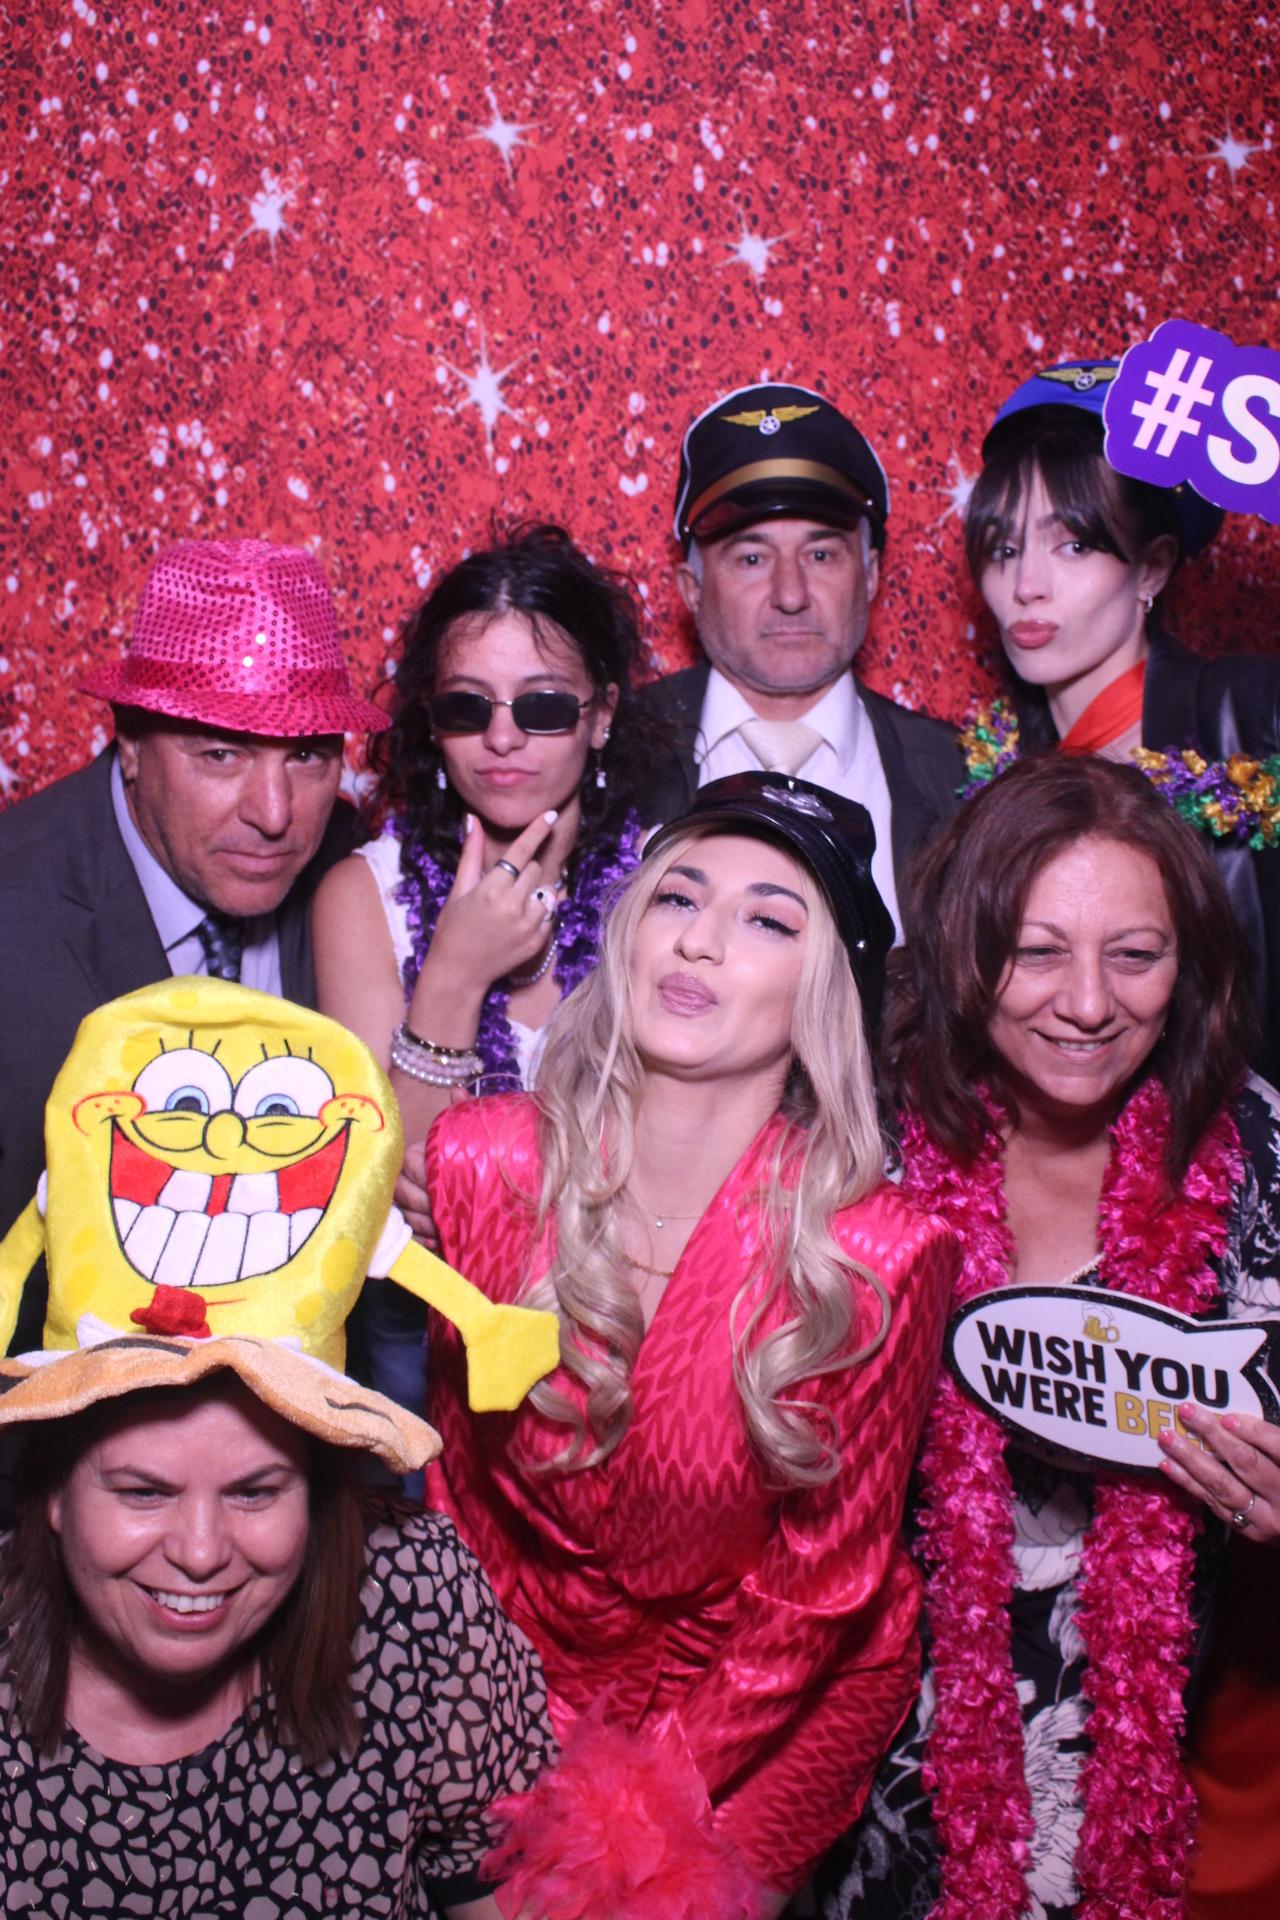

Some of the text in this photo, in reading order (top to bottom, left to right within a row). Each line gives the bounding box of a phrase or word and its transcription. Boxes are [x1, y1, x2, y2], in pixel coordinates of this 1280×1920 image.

[976, 1320, 1230, 1409] WISH YOU
[981, 1364, 1108, 1427] WERE
